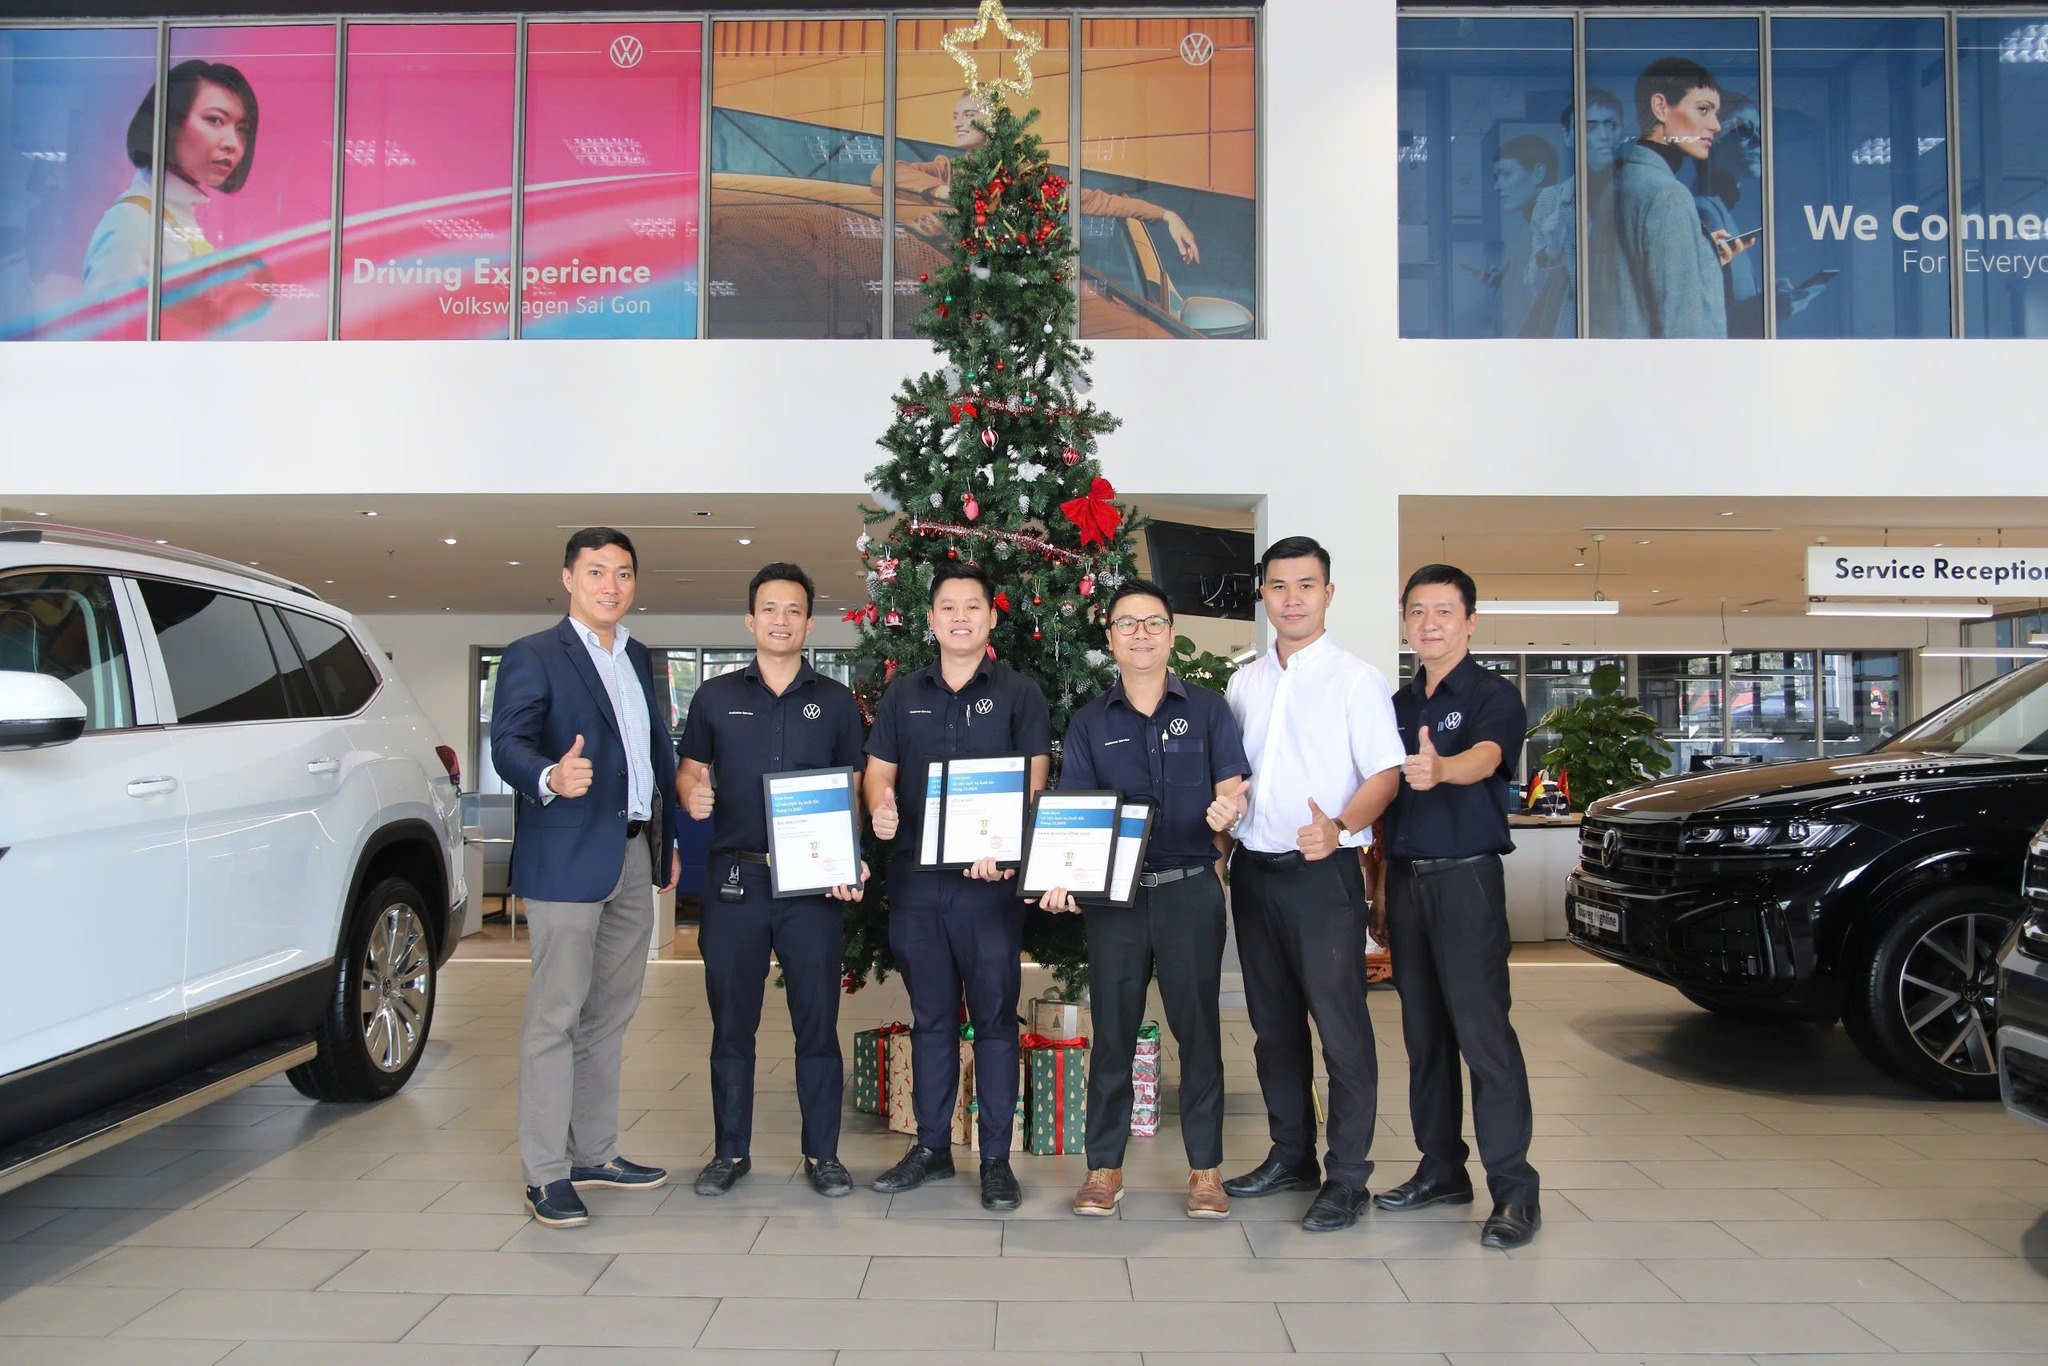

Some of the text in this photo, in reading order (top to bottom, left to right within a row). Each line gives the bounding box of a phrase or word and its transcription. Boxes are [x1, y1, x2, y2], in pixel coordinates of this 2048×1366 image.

[1803, 204, 2048, 241] We Conne
[353, 257, 651, 291] Driving Experience
[1903, 249, 1947, 274] For
[439, 296, 650, 319] Volkswagen Sai Gon
[1835, 557, 2048, 586] Service Receptio
